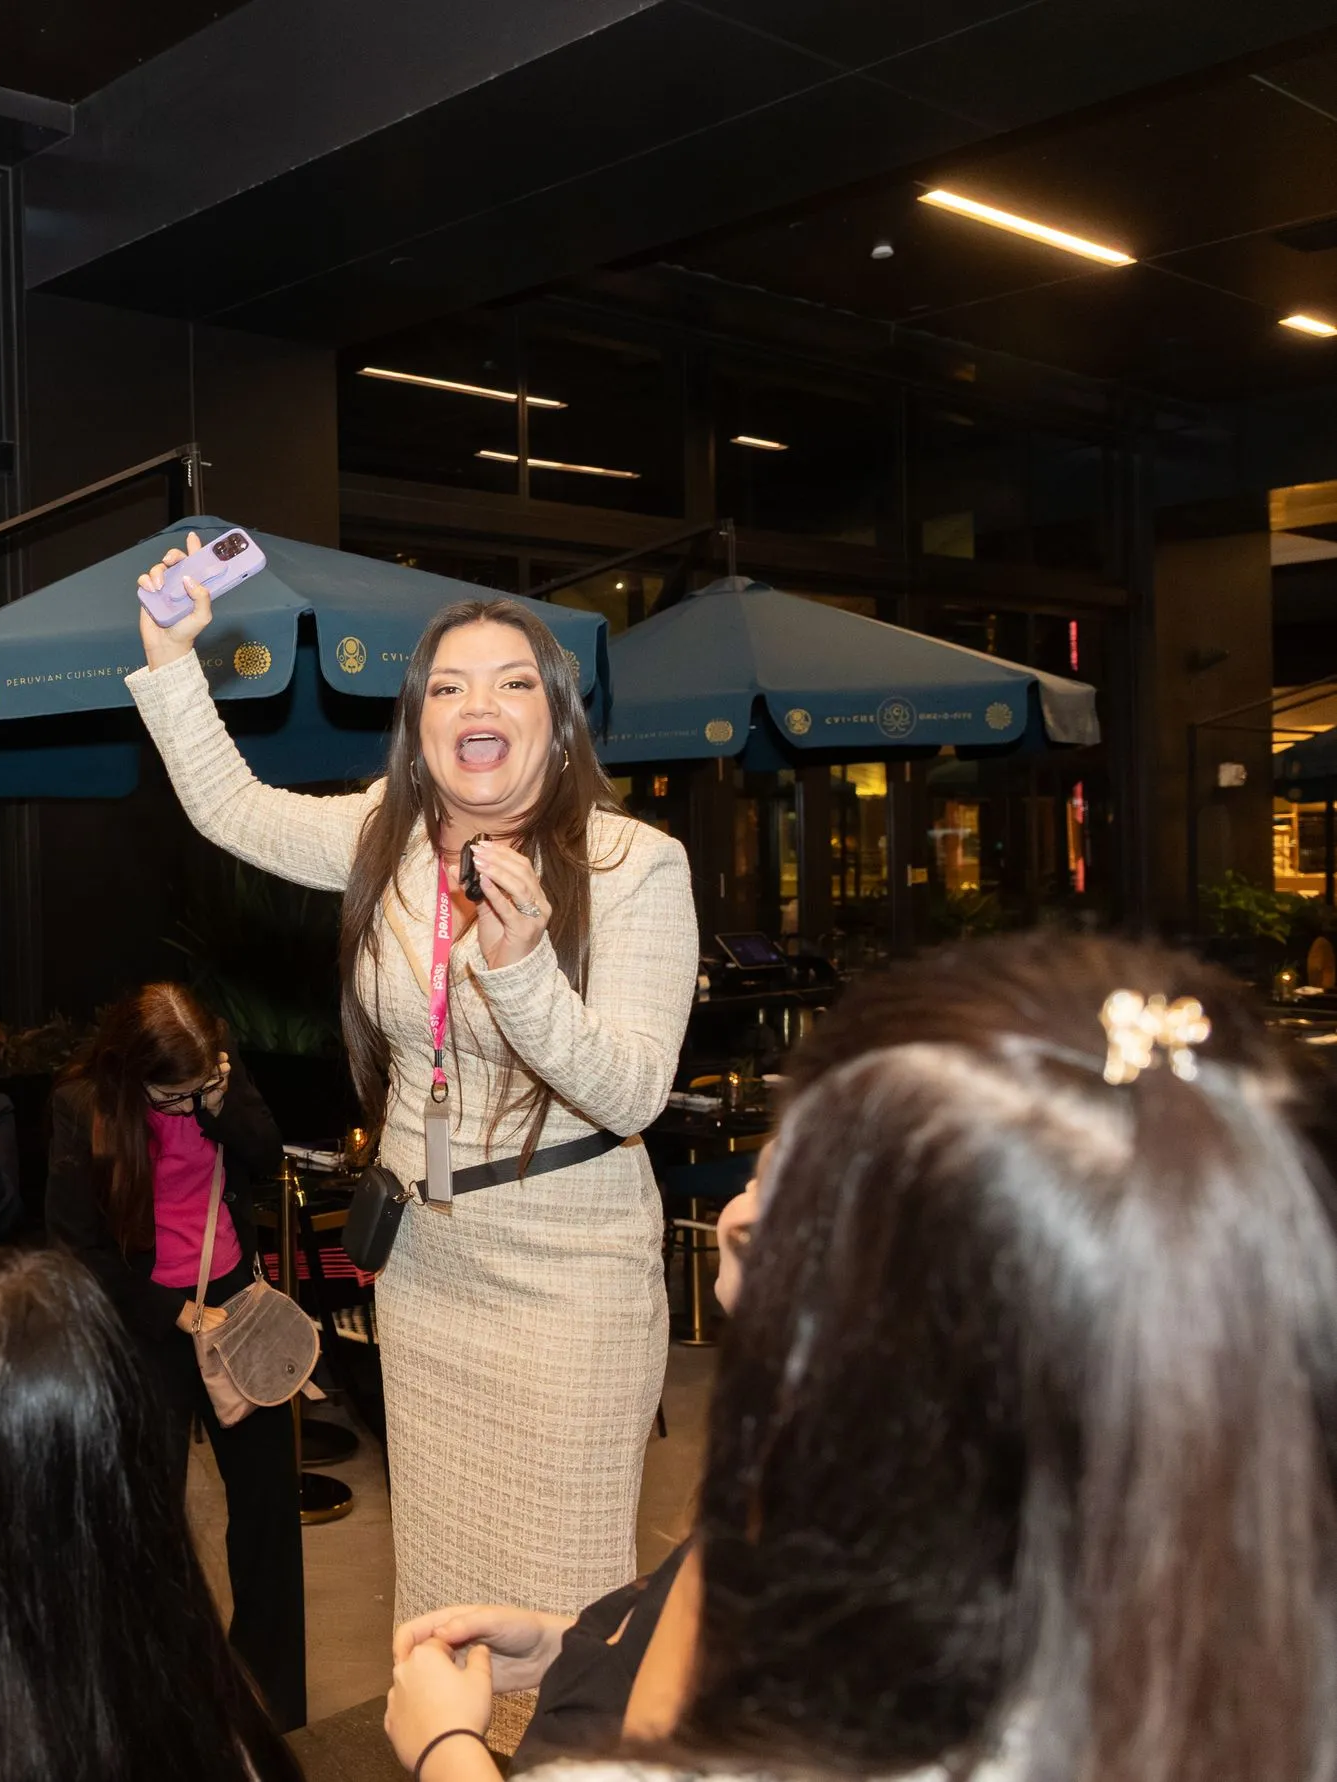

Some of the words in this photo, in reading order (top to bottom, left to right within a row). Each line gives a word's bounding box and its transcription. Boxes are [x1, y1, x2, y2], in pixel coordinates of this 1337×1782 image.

[6, 674, 62, 687] PERUVIAN
[66, 667, 112, 680] CUISINE
[116, 666, 130, 675] BY
